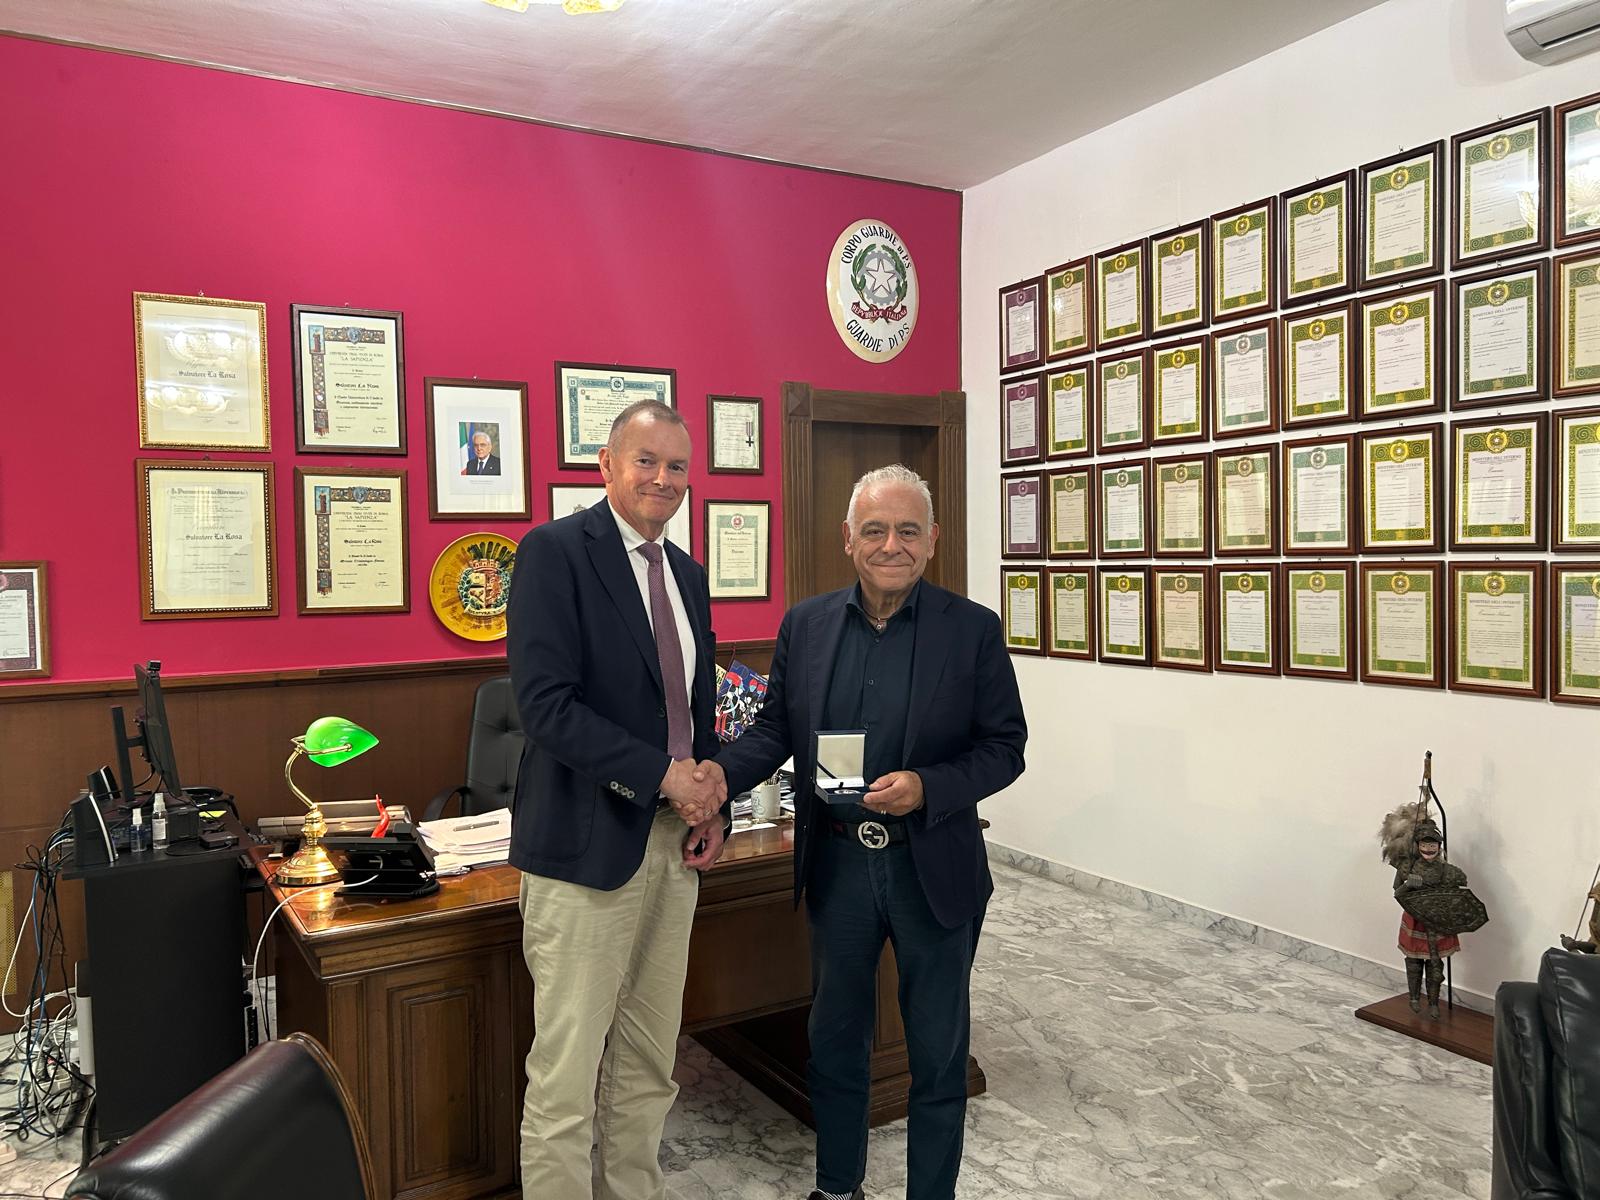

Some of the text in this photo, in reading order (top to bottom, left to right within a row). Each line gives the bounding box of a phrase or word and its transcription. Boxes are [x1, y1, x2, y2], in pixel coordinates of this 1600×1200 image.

[841, 234, 862, 264] CORPO
[860, 225, 899, 247] GUARDIE
[897, 245, 904, 255] DI
[846, 319, 884, 353] GUARDIE
[888, 334, 899, 350] DI
[207, 370, 217, 378] La
[218, 371, 236, 379] Rosa
